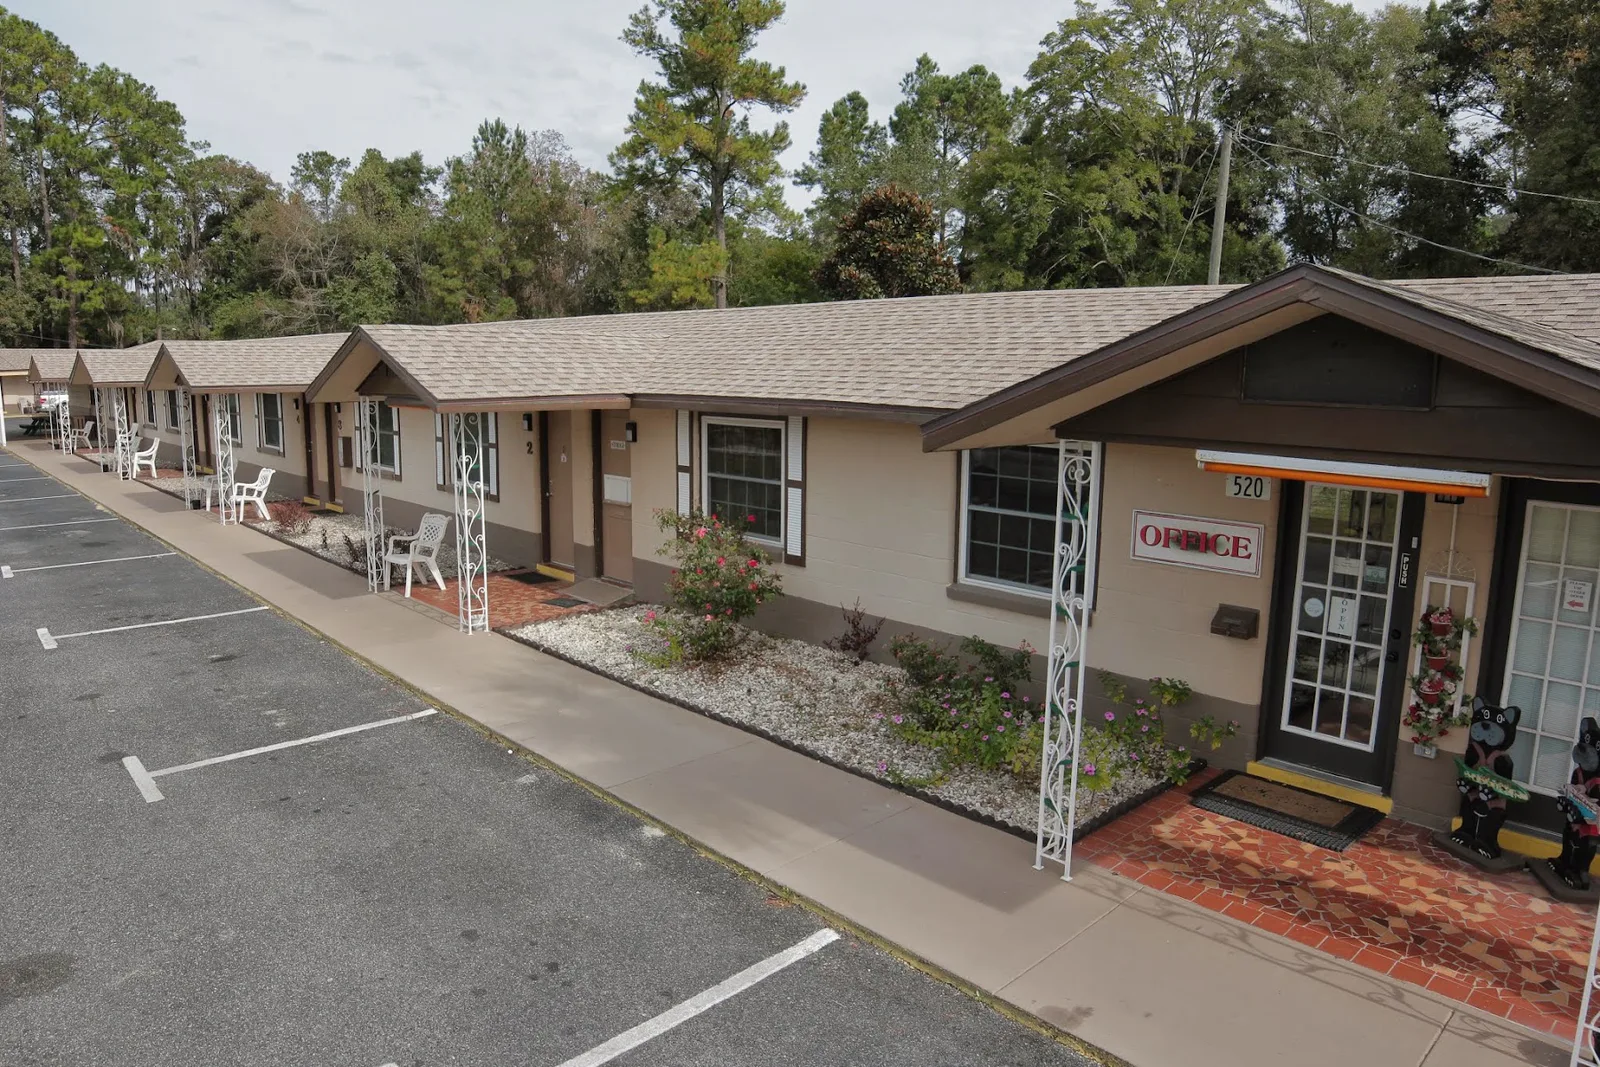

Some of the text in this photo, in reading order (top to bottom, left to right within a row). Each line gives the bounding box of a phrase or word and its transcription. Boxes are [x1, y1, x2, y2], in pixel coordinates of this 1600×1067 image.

[526, 441, 534, 455] 2
[1233, 475, 1264, 498] 520
[1139, 524, 1253, 560] OFFICE
[1400, 556, 1410, 585] PUSH
[1338, 599, 1349, 631] OPEN
